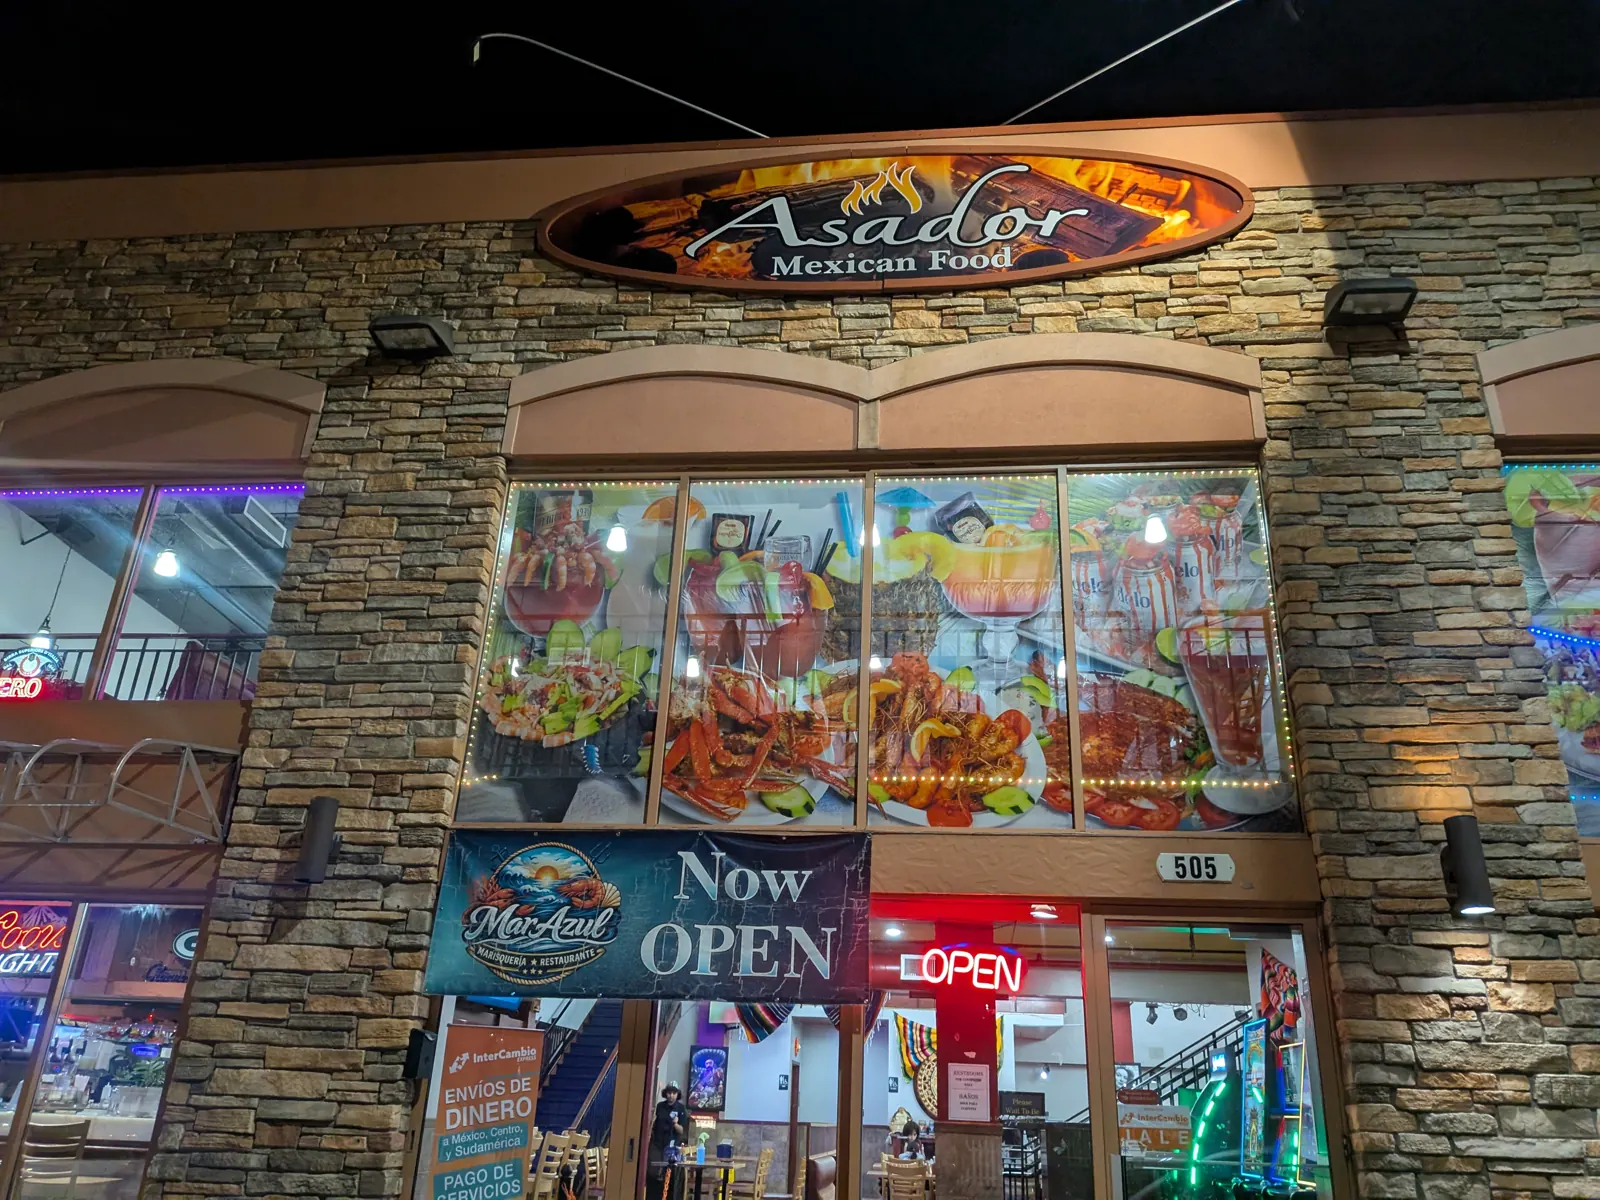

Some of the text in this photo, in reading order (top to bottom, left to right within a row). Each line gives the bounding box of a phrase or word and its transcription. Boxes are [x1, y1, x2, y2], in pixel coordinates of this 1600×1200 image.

[685, 164, 1088, 258] Asador
[771, 246, 1013, 276] Mexican Food
[673, 851, 813, 903] Now
[1174, 855, 1218, 880] 505
[477, 946, 596, 966] MARISQUERÍA RESTAURANTE
[640, 923, 837, 980] OPEN
[922, 948, 1022, 992] OPEN
[473, 1046, 536, 1064] InterCambio
[445, 1077, 532, 1105] ENVÍOS DE
[445, 1096, 533, 1130] DINERO
[443, 1125, 523, 1146] a México, Centro,
[445, 1137, 521, 1161] y Sudamérica
[444, 1163, 514, 1191] PAGO DE
